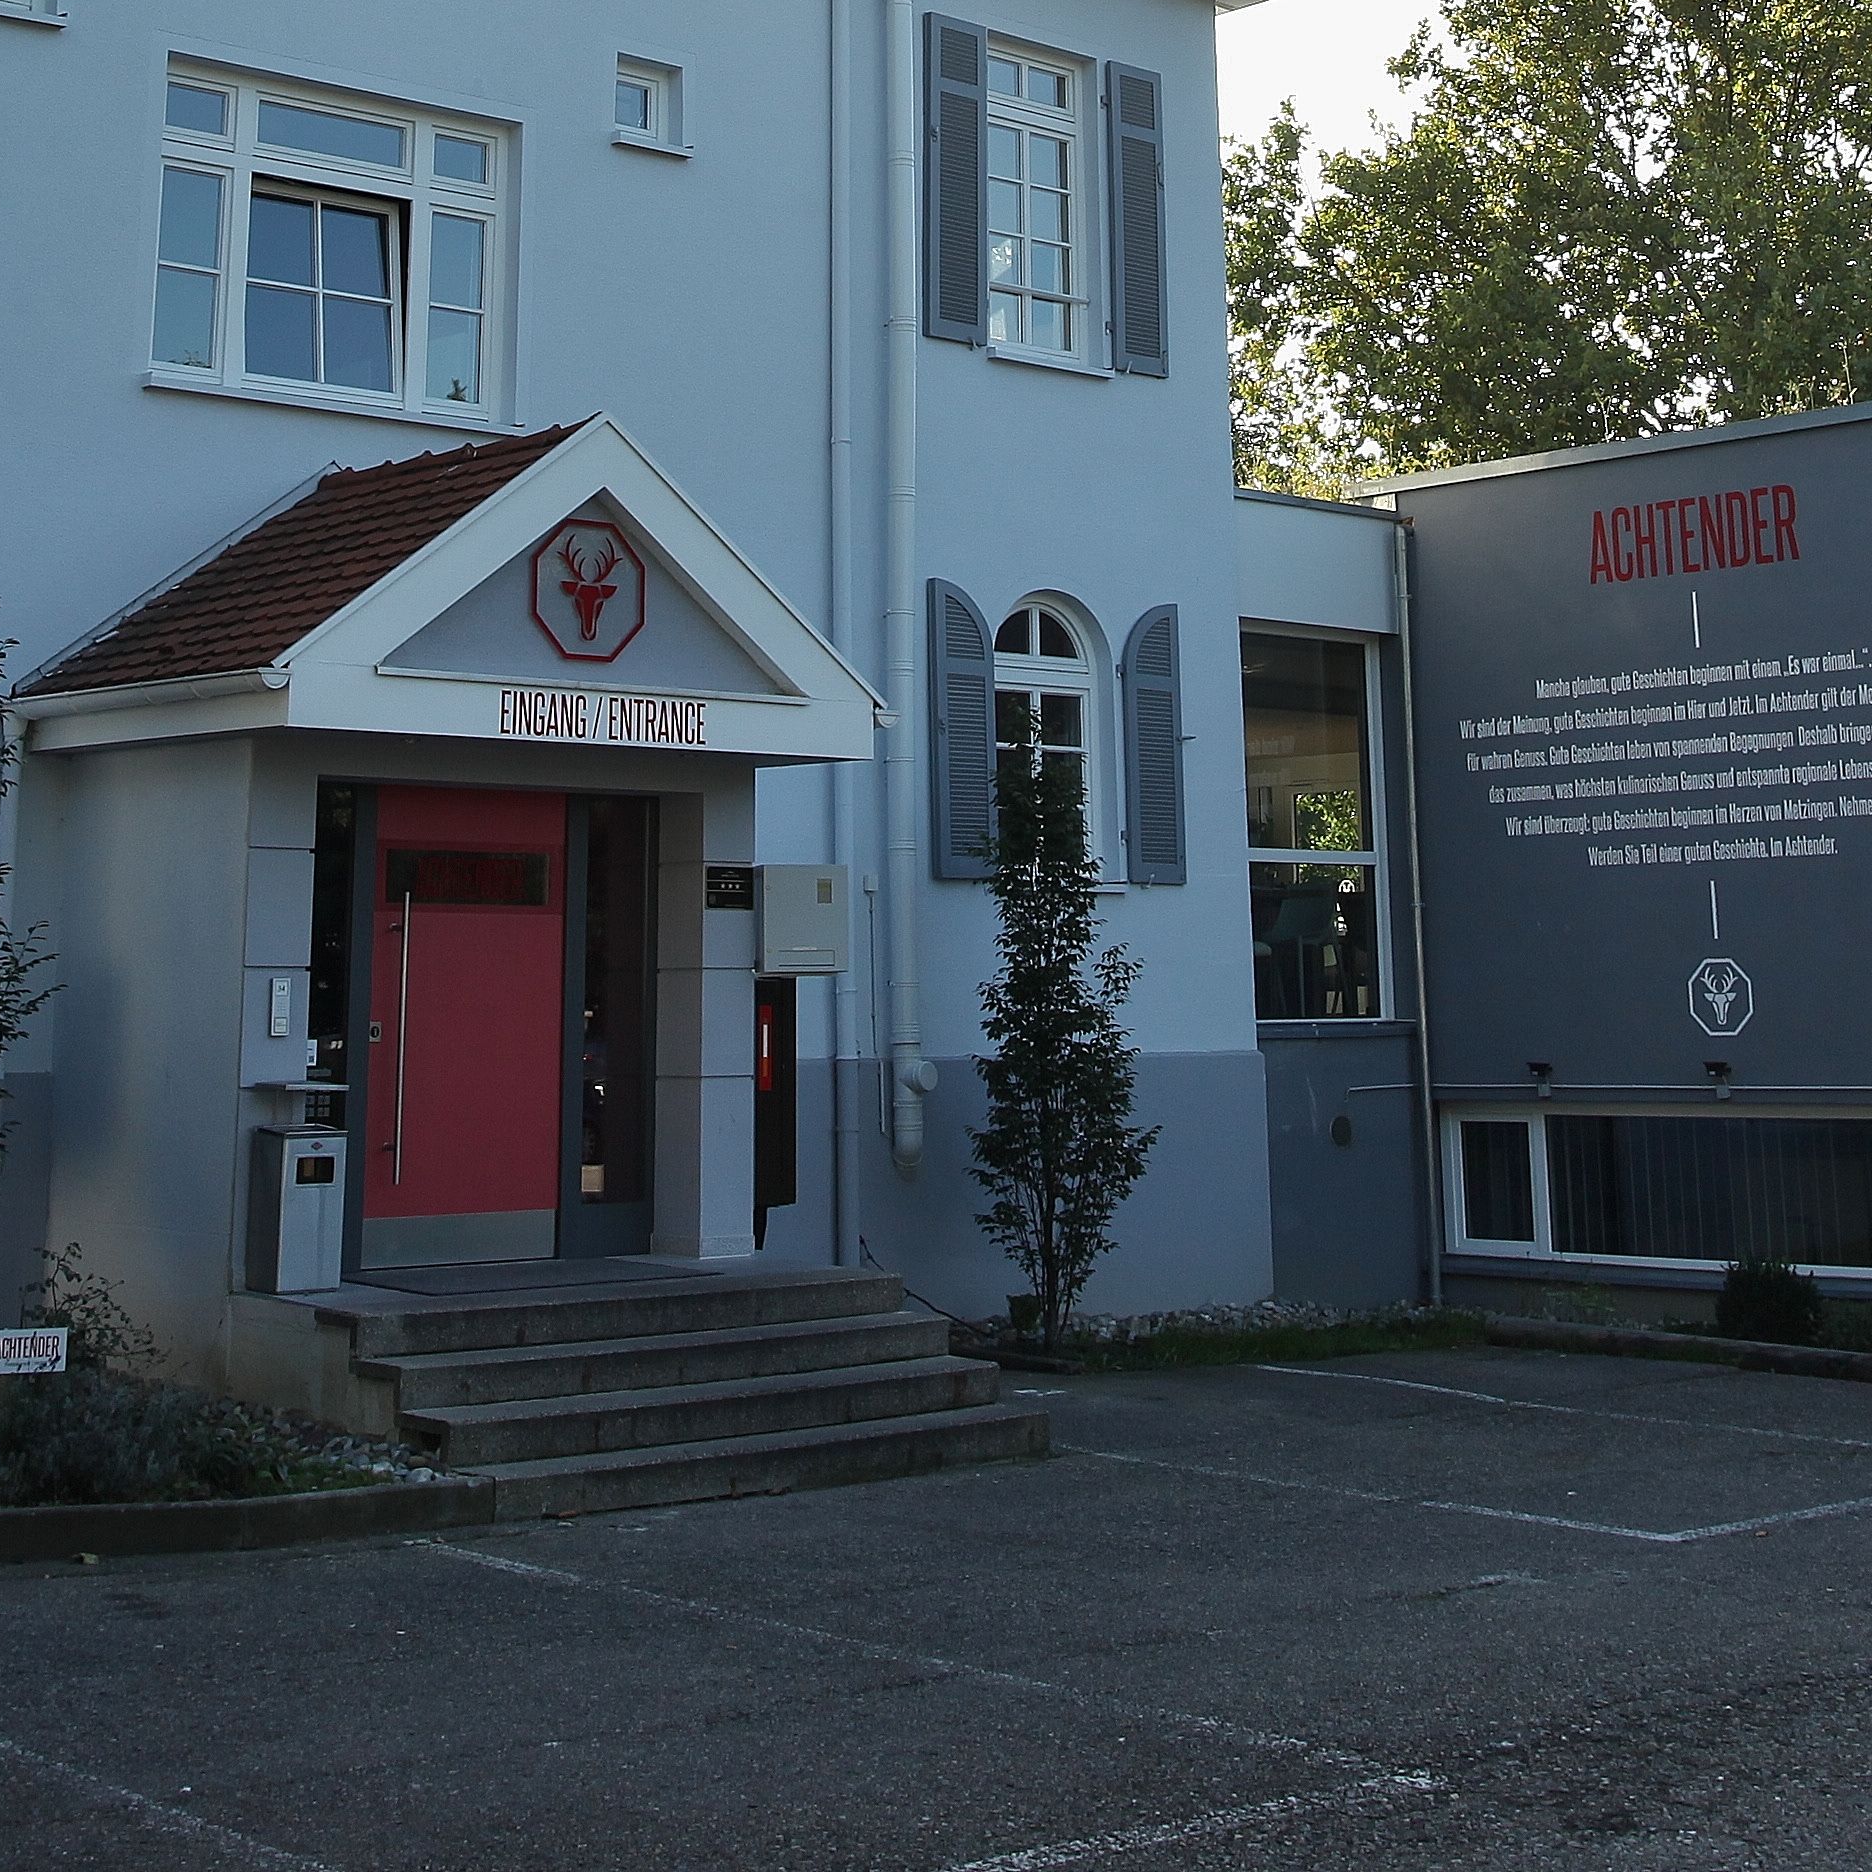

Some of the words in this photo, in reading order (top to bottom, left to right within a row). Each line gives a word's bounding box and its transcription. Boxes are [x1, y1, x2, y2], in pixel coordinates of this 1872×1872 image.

[1589, 484, 1801, 584] ACHTENDER
[1535, 677, 1571, 699] Manche
[1610, 671, 1632, 695] gute
[1631, 665, 1689, 690] Geschichten
[1689, 661, 1734, 688] beginnen
[1733, 659, 1751, 681] mit
[1751, 656, 1782, 679] einem
[1801, 656, 1822, 675] war
[499, 690, 587, 739] EINGANG
[608, 697, 707, 746] ENTRANCE
[1459, 719, 1477, 740] Wir
[1476, 717, 1496, 739] sind
[1496, 716, 1513, 737] der
[1552, 710, 1575, 735] gute
[1574, 705, 1630, 730] Geschichten
[1630, 701, 1673, 728] beginnen
[1673, 700, 1686, 721] im
[1686, 698, 1707, 720] Hier
[1707, 696, 1727, 719] und
[1727, 694, 1755, 717] Jetzt.
[1754, 692, 1768, 714] Im
[1768, 688, 1820, 713] Achtender
[1820, 686, 1839, 712] gilt
[1839, 685, 1858, 707] der
[1466, 752, 1481, 772] für
[1513, 746, 1548, 769] Genuss.
[1548, 744, 1570, 766] Gute
[1570, 740, 1626, 765] Geschichten
[1626, 738, 1652, 760] leben
[1652, 740, 1671, 758] von
[1671, 731, 1729, 760] spannenden
[1797, 723, 1838, 747] Deshalb
[1488, 784, 1505, 804] das
[1554, 782, 1574, 800] was
[1574, 775, 1616, 798] höchsten
[1616, 771, 1679, 796] kulinarischen
[1679, 768, 1715, 791] Genuss
[1715, 766, 1736, 789] und
[1735, 763, 1791, 790] entspannte
[1791, 759, 1838, 787] regionale
[1505, 816, 1524, 837] Wir
[1522, 814, 1544, 836] sind
[1591, 811, 1613, 835] gute
[1613, 806, 1670, 831] Geschichten
[1670, 804, 1715, 830] beginnen
[1714, 803, 1728, 825] im
[1728, 801, 1763, 824] Herzen
[1763, 804, 1783, 822] von
[1783, 796, 1839, 824] Metzingen.
[1587, 844, 1624, 867] Werden
[1624, 843, 1640, 865] Sie
[1640, 843, 1658, 865] Teil
[1658, 841, 1684, 864] einer
[1683, 840, 1712, 865] guten
[1712, 836, 1769, 861] Geschichte.
[1769, 836, 1784, 858] Im
[1783, 833, 1839, 857] Achtender.
